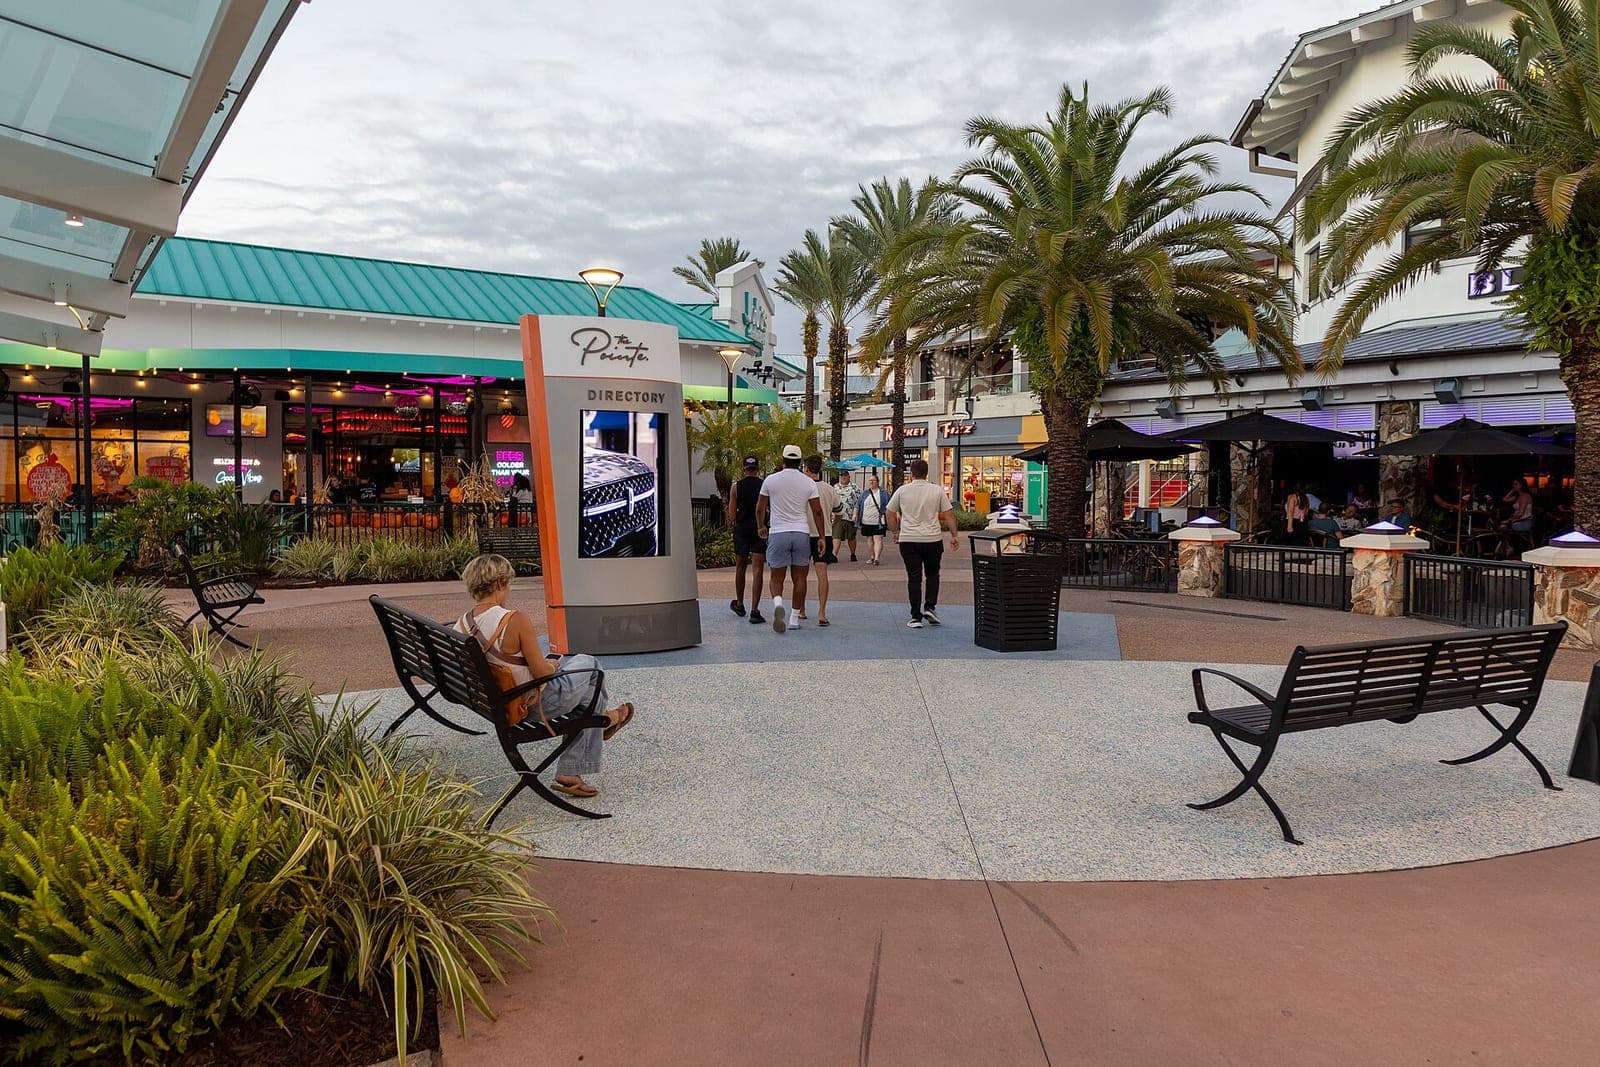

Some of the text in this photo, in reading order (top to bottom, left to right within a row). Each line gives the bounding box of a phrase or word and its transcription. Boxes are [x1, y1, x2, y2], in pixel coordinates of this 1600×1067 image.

[1468, 269, 1524, 297] BL
[614, 334, 632, 345] the
[588, 390, 666, 404] DIRECTORY
[880, 423, 928, 441] RKET
[496, 450, 525, 462] BEER
[215, 471, 236, 485] Goo
